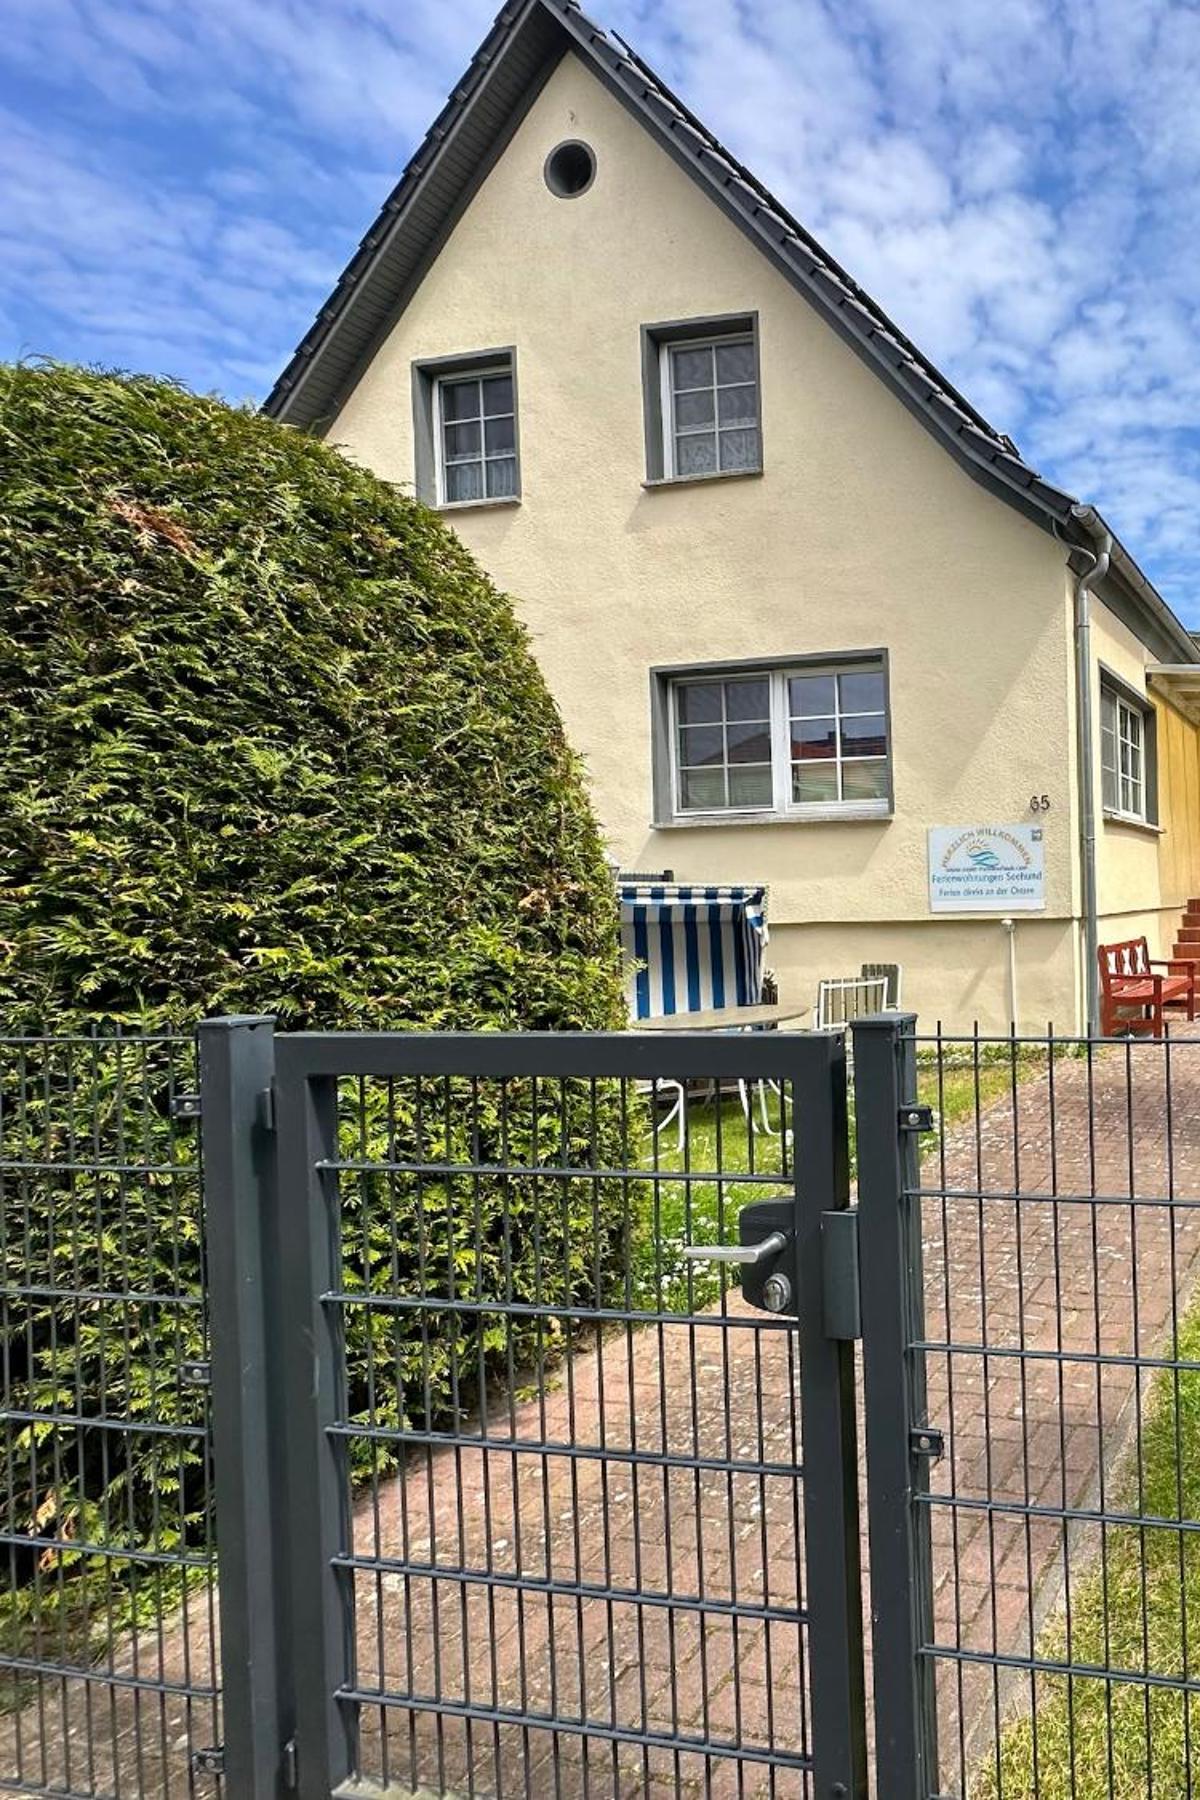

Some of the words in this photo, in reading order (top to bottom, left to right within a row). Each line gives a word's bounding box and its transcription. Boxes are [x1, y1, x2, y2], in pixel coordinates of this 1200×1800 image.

[1030, 794, 1051, 812] 65
[932, 873, 1004, 884] Ferienwohnungen
[1006, 871, 1043, 881] Seehund
